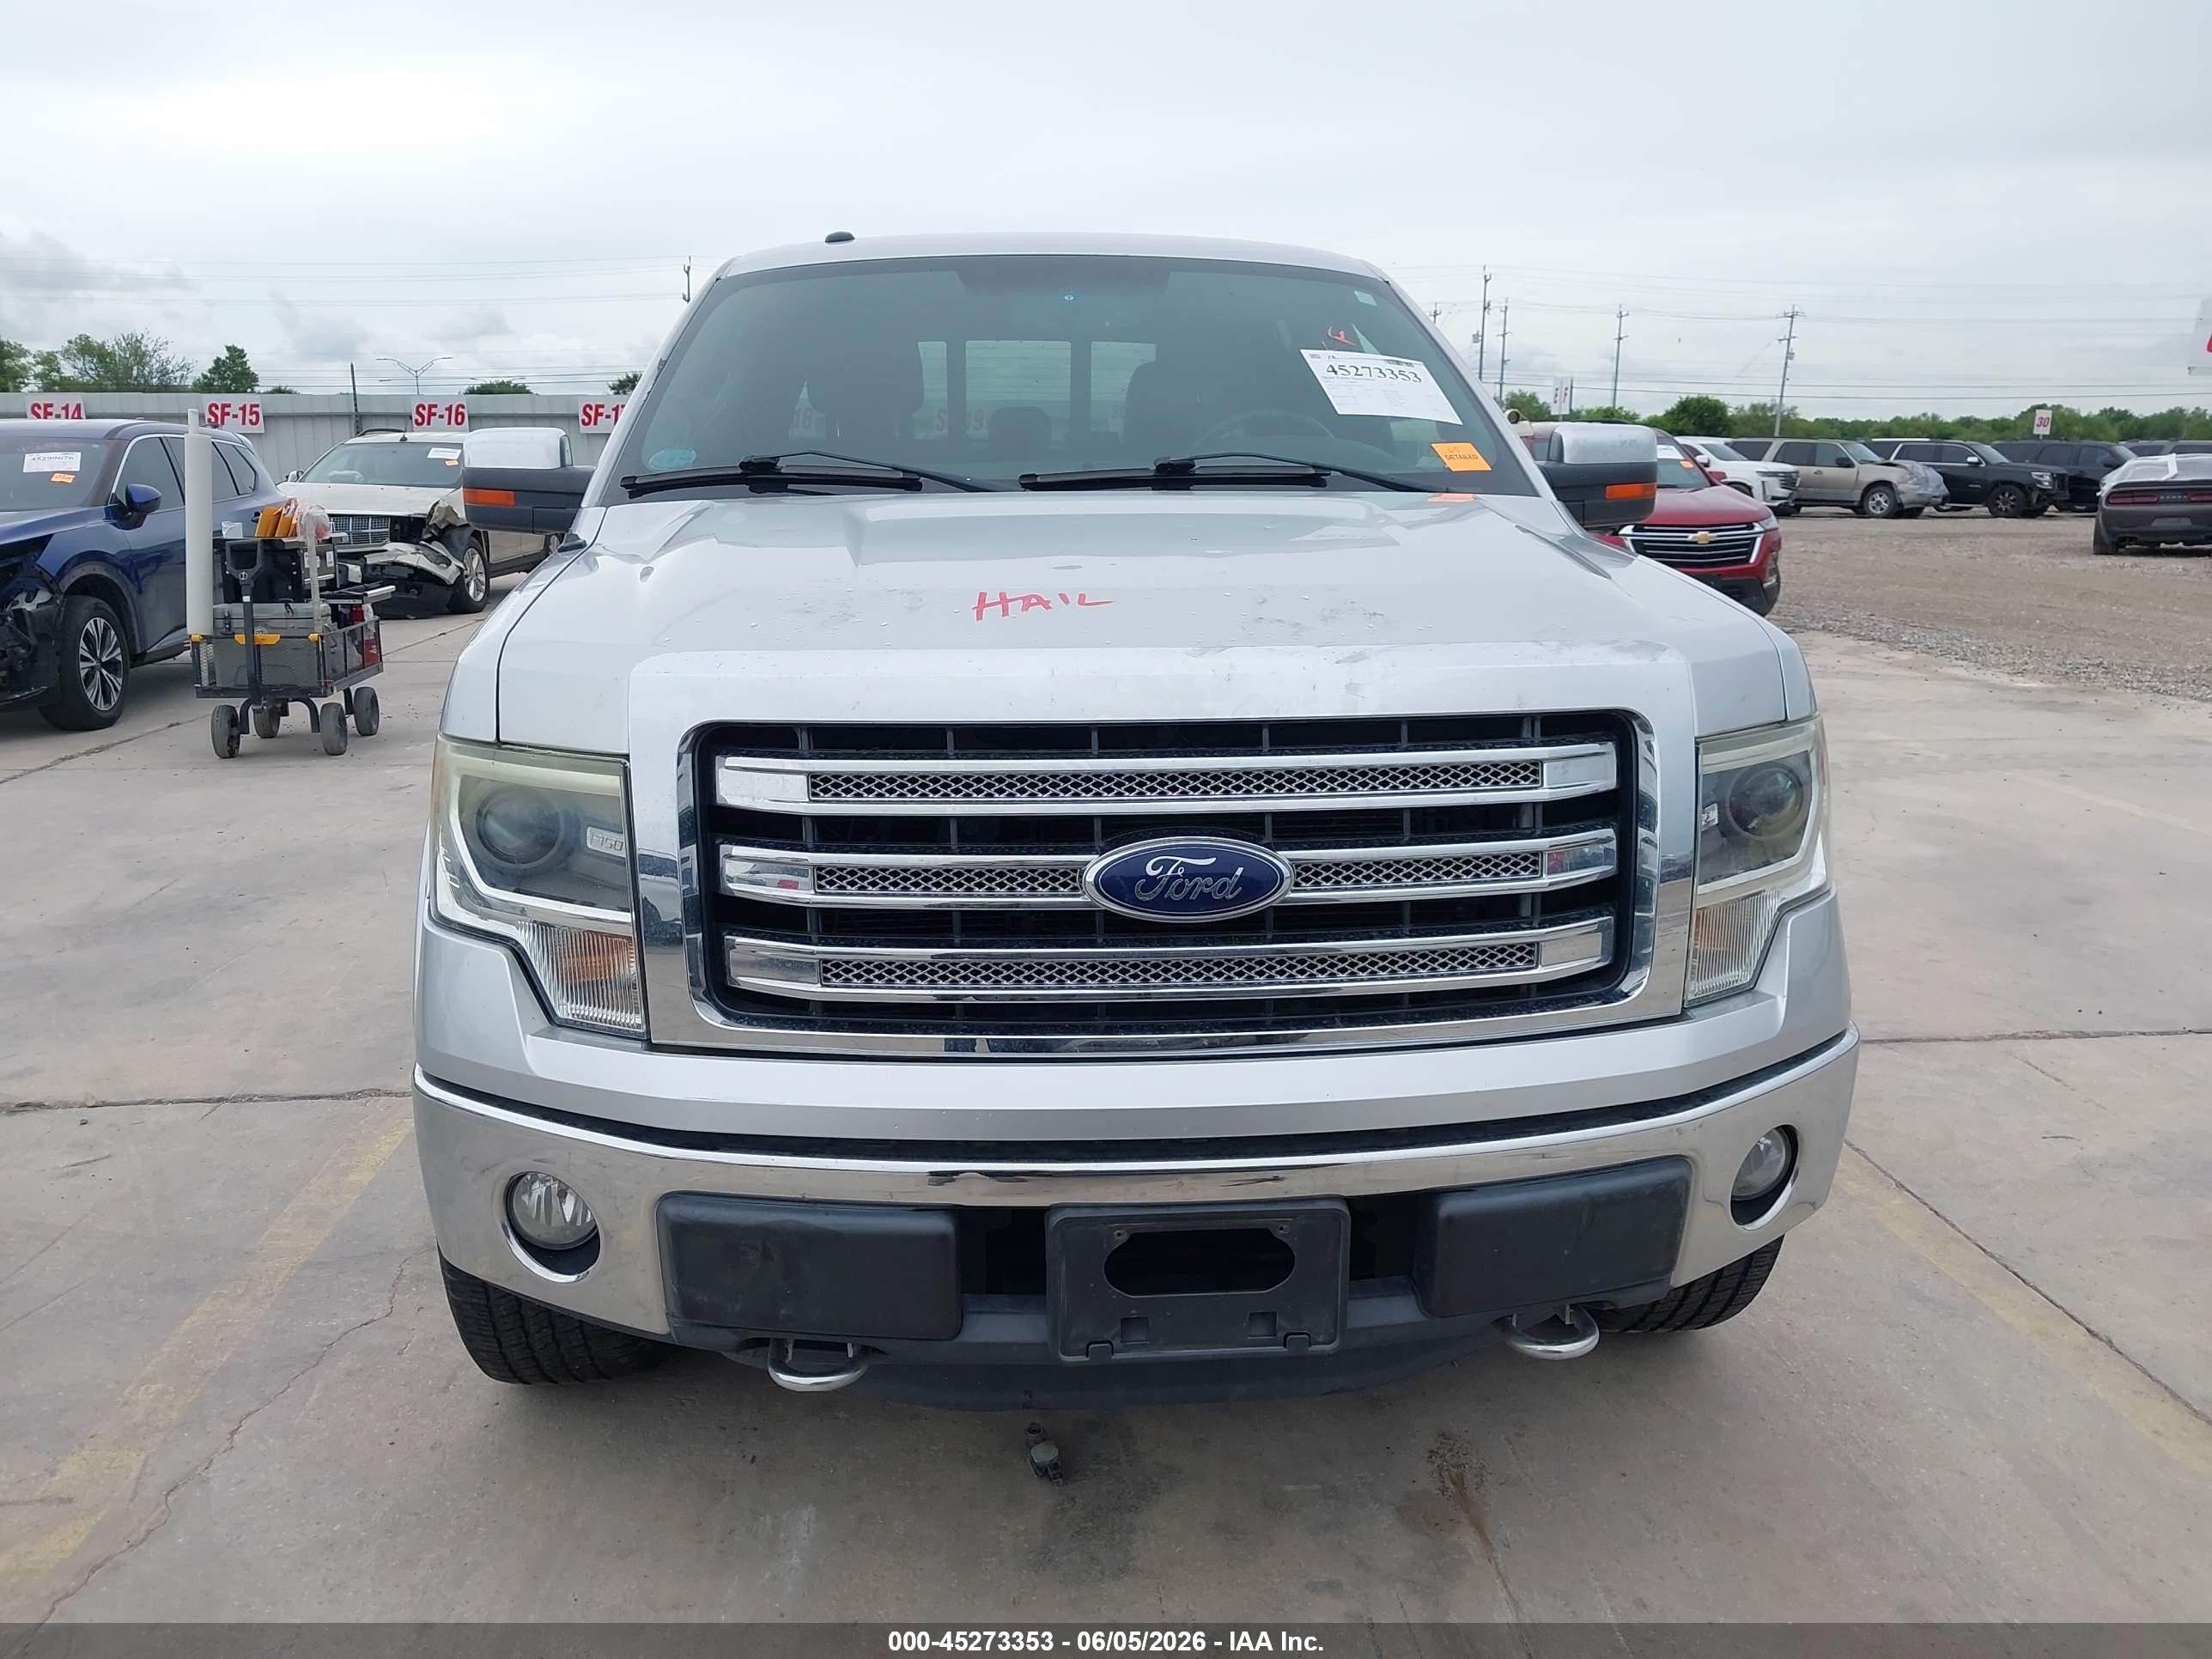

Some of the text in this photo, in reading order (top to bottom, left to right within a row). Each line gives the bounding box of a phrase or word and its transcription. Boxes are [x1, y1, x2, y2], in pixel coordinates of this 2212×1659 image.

[1326, 363, 1422, 384] 45273353
[29, 402, 82, 420] SF-14
[207, 403, 260, 426] SF-15
[414, 403, 466, 426] SF-16
[2037, 416, 2050, 428] 30
[972, 591, 1115, 622] HAIL
[1134, 855, 1244, 902] Ford
